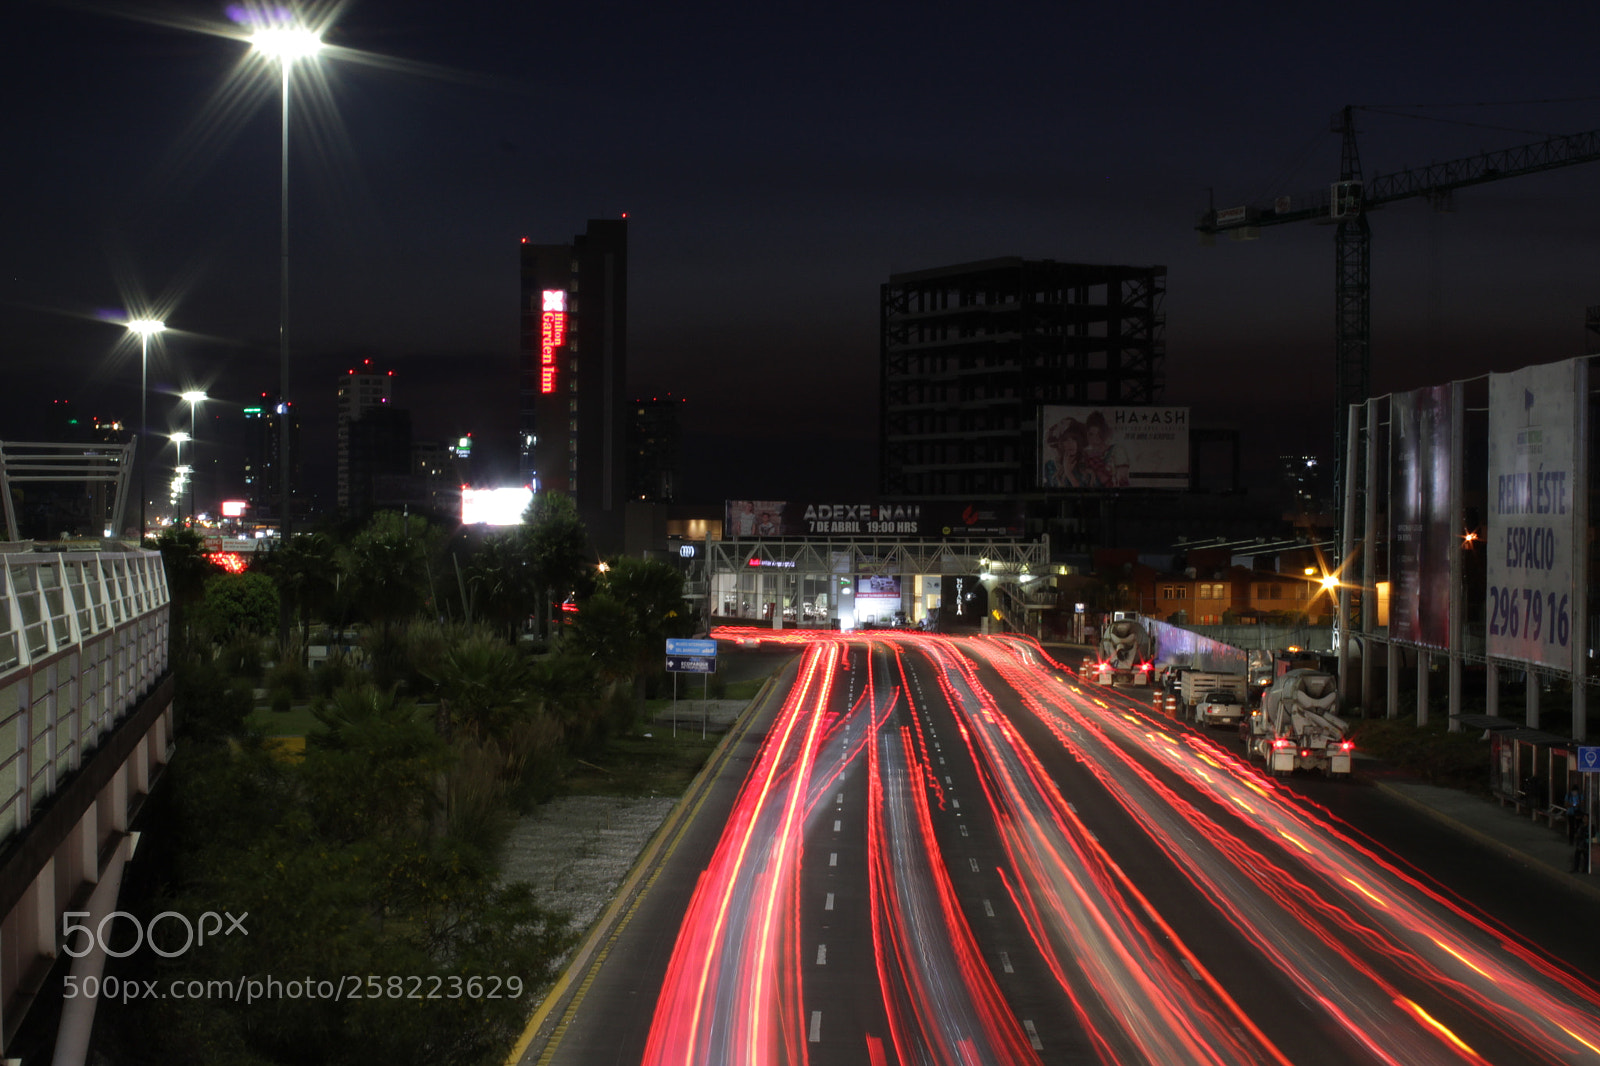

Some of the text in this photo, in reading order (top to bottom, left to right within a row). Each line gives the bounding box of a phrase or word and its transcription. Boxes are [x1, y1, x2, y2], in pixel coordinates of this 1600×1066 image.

[554, 312, 563, 346] Hilton
[542, 312, 554, 393] Garden Inn
[1497, 462, 1566, 515] RENTA ÉSTE
[803, 504, 871, 521] ADEXE
[809, 521, 918, 533] 7 DE ABRIL 19:00 HRS
[1506, 527, 1554, 571] ESPACIO
[1489, 586, 1569, 647] 296 79 16
